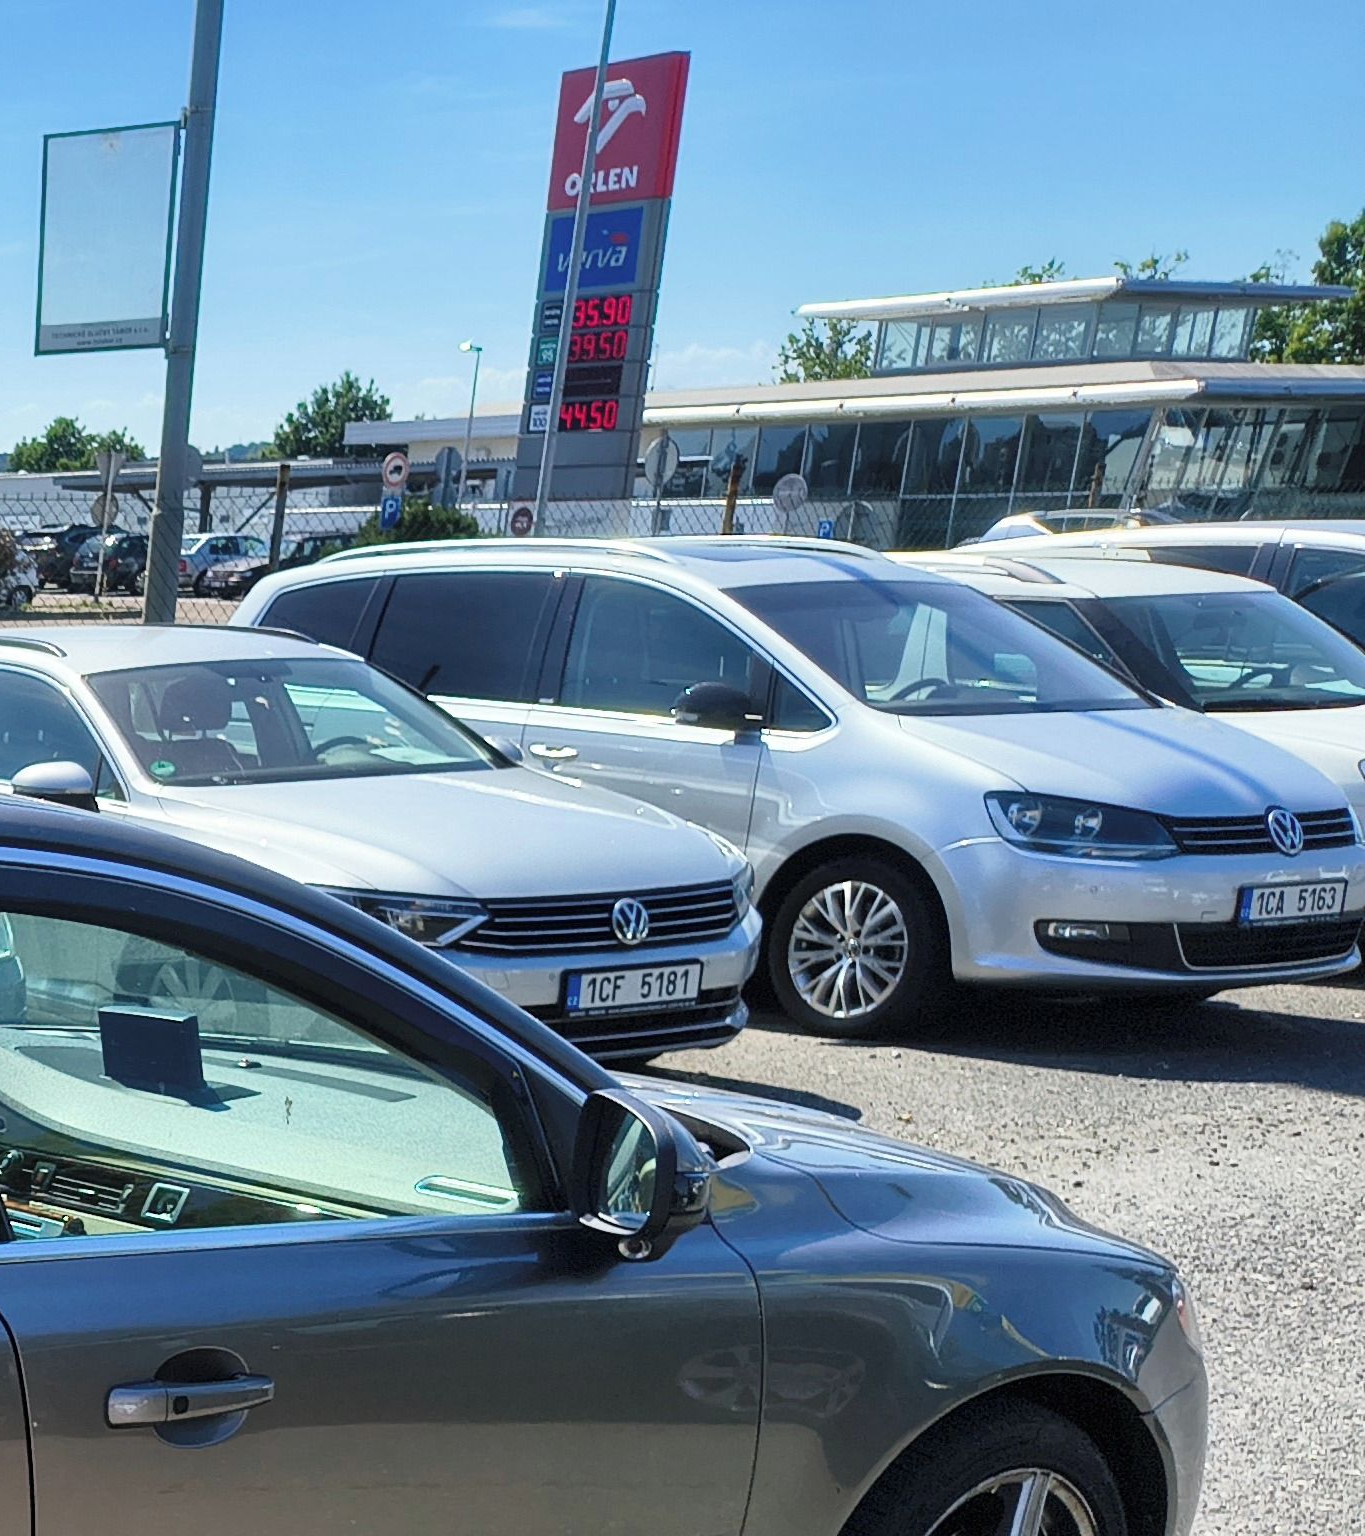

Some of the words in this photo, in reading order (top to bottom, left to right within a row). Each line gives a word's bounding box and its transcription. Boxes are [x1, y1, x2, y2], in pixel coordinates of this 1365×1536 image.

[558, 245, 627, 272] vrva
[1257, 890, 1285, 916] 1CA
[1297, 886, 1337, 913] 5163
[587, 975, 625, 1004] 1CF
[640, 969, 690, 999] 5181
